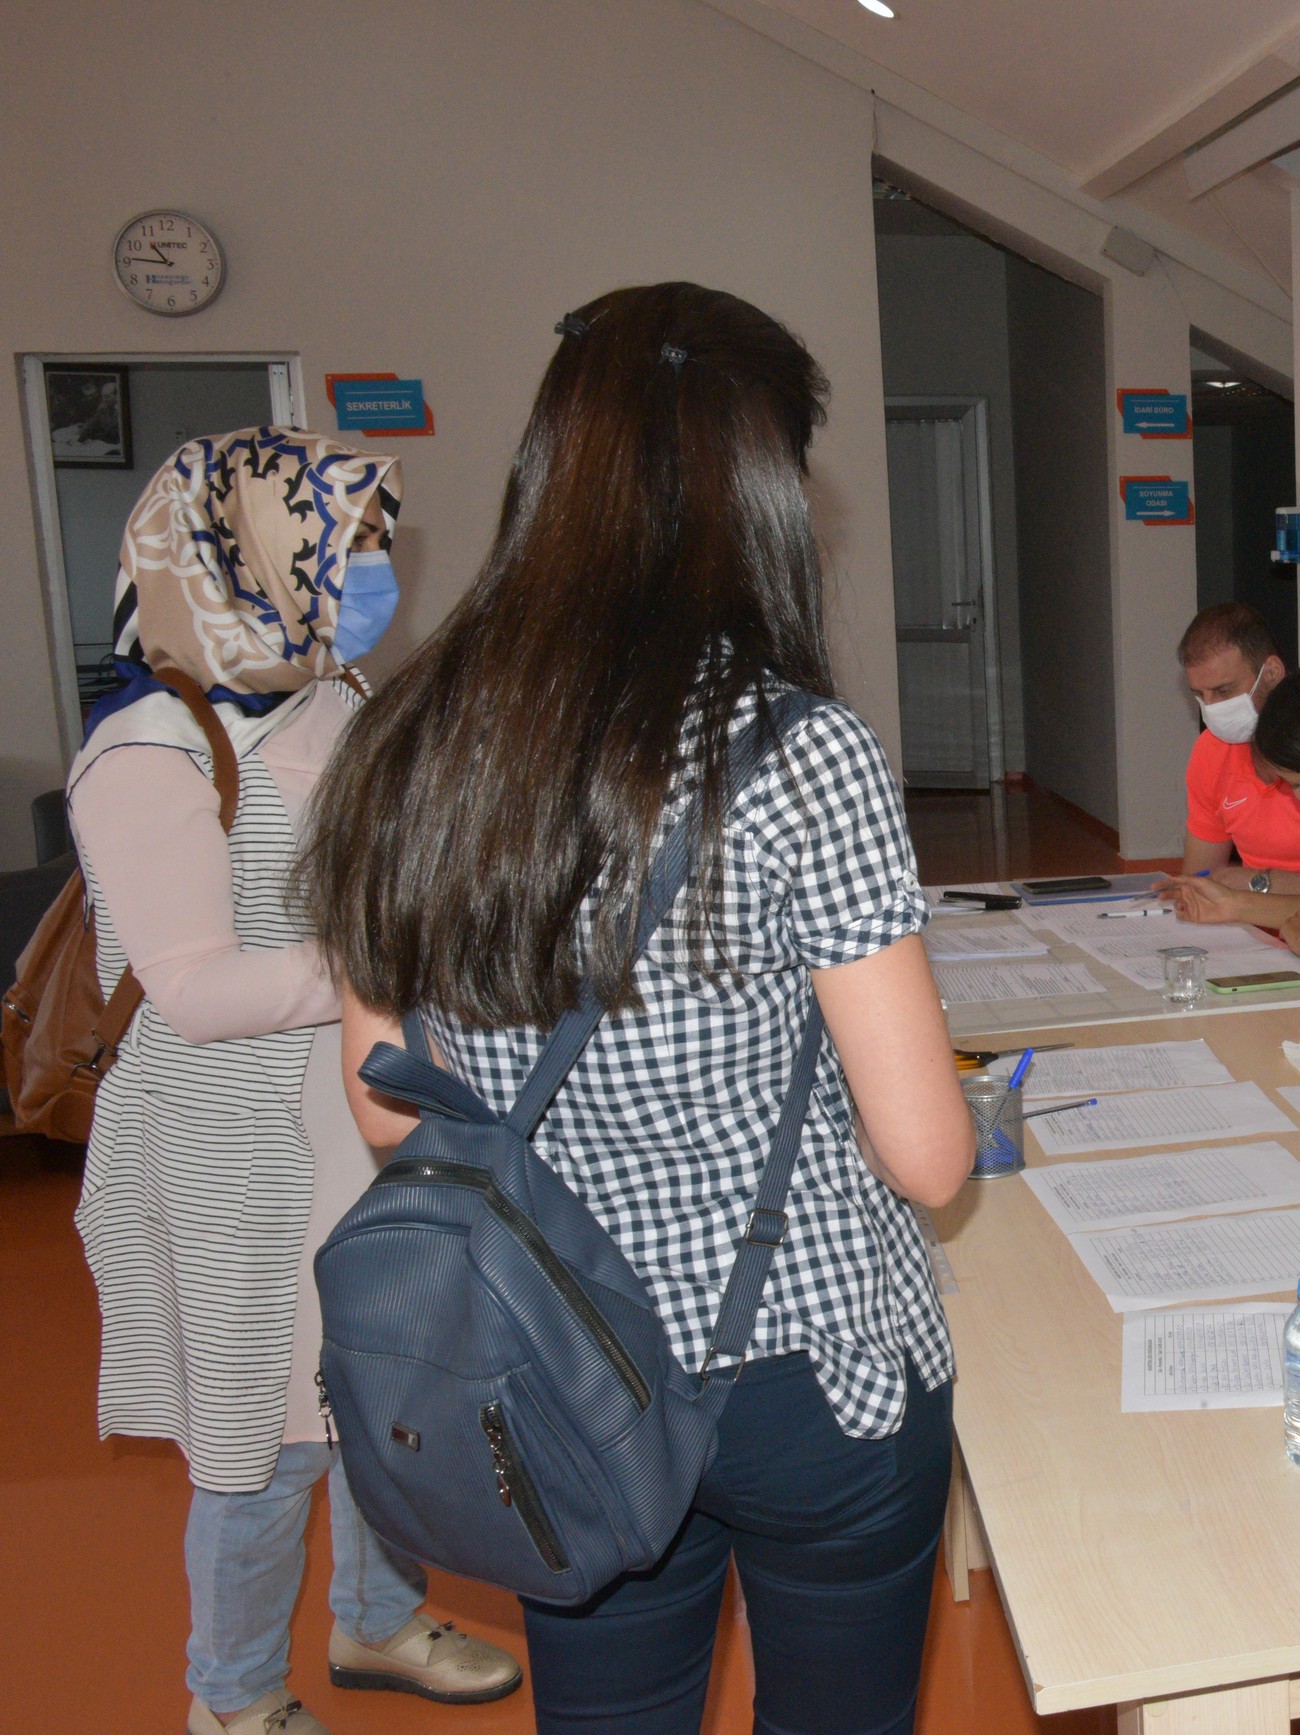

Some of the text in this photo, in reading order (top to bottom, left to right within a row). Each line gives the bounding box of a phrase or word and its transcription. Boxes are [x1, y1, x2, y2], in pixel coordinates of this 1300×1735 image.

[141, 225, 155, 237] 11
[159, 219, 175, 232] 12
[186, 226, 192, 238] 1
[128, 239, 142, 251] 10
[199, 241, 208, 254] 2
[122, 256, 132, 269] 9
[206, 259, 215, 271] 3
[129, 273, 139, 286] 8
[201, 275, 211, 287] 4
[145, 288, 154, 300] 7
[189, 289, 198, 302] 5
[167, 296, 176, 307] 6
[345, 399, 412, 412] SEKRETERLİK
